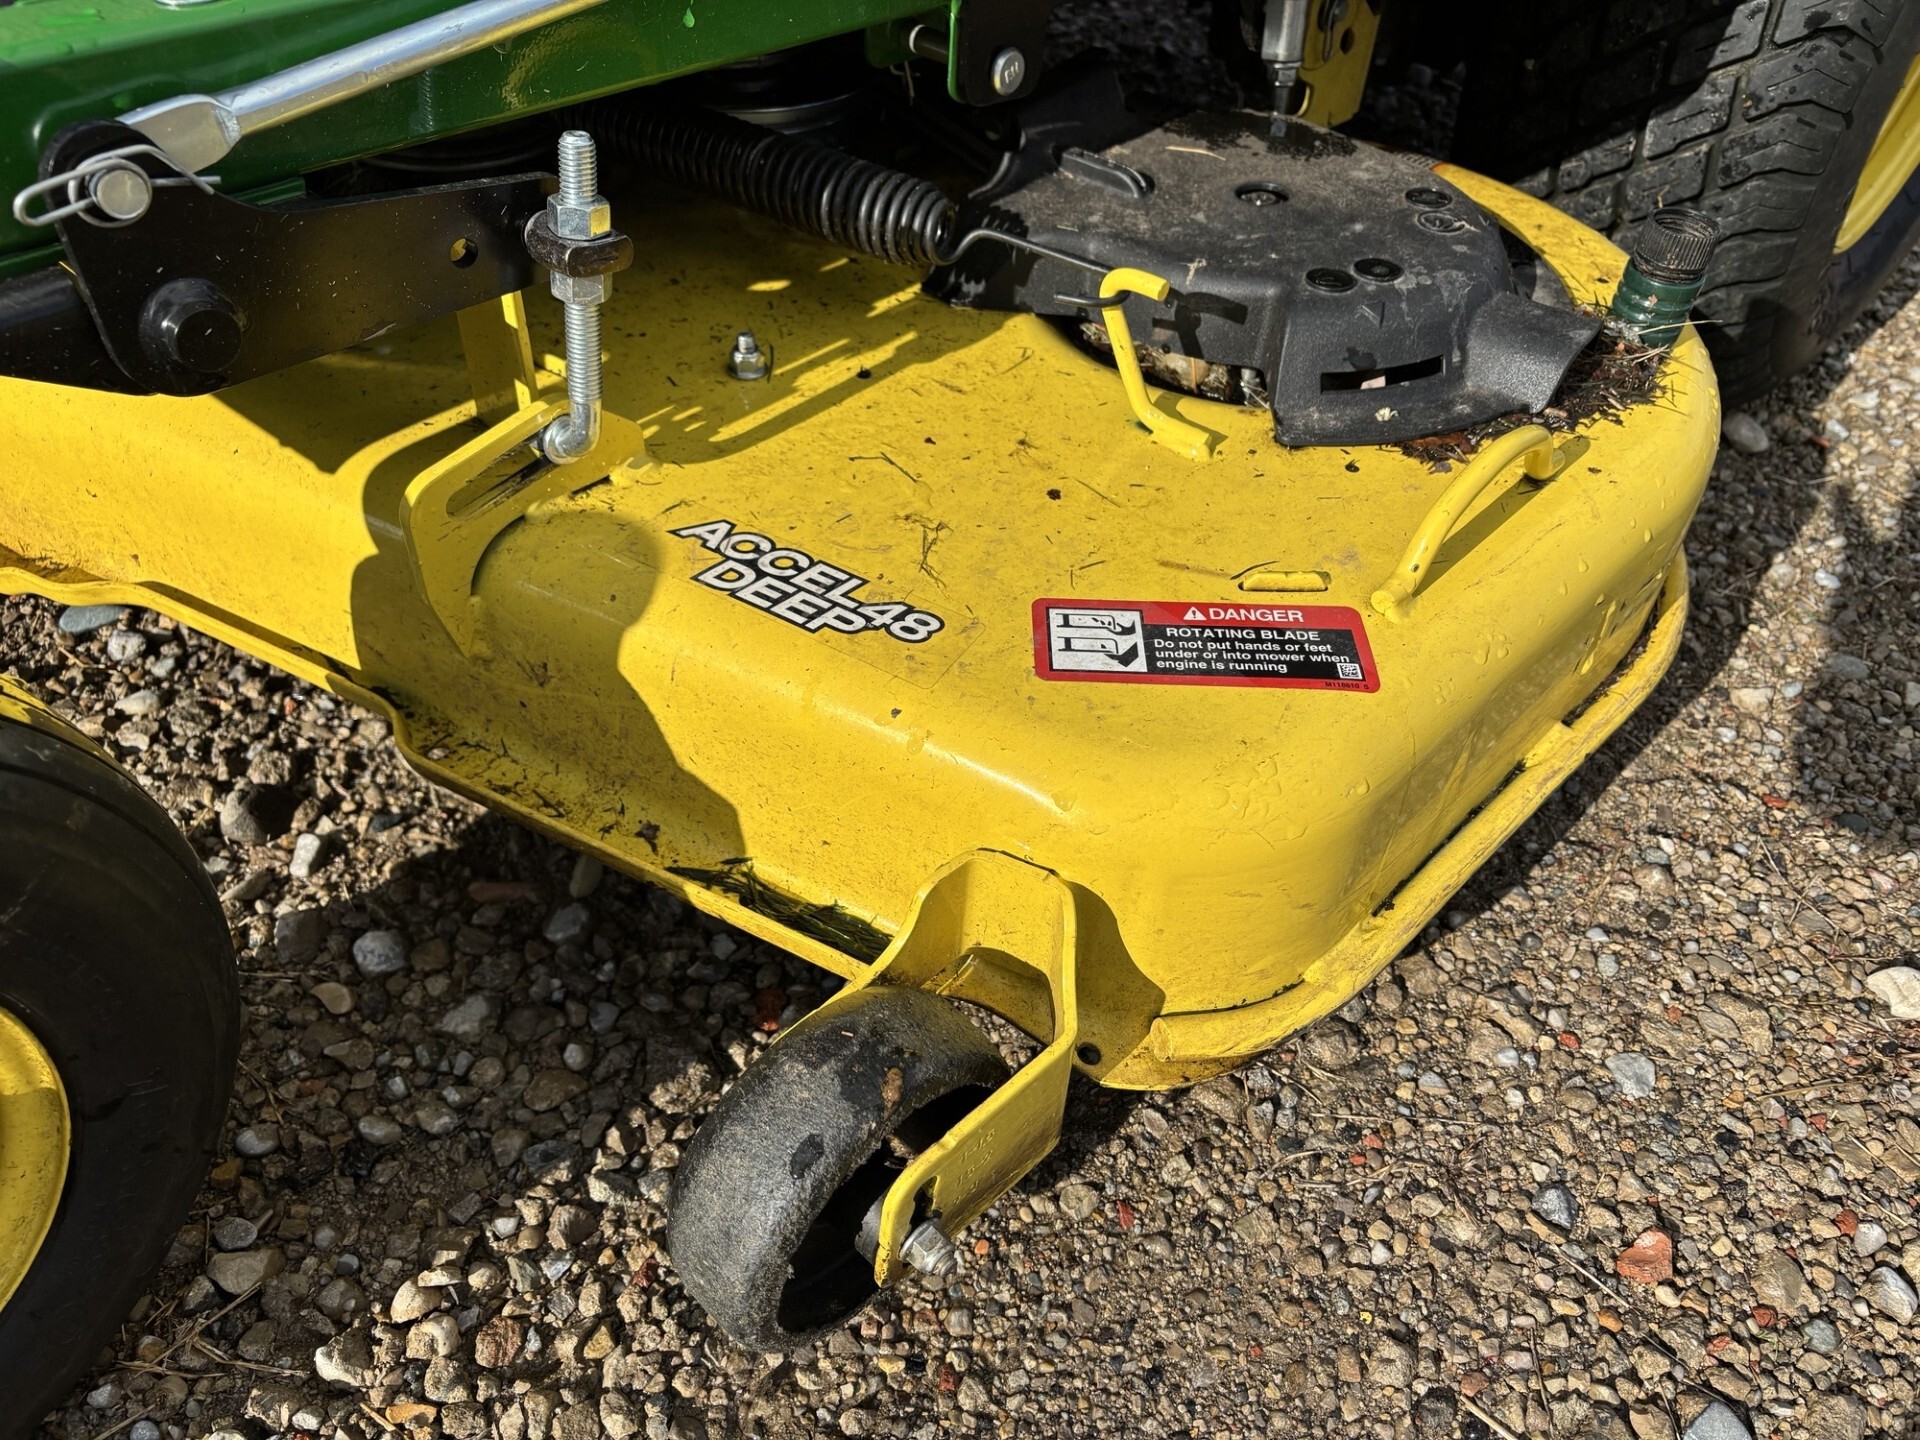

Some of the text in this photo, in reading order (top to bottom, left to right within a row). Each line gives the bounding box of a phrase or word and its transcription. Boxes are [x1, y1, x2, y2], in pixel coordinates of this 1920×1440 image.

[669, 520, 868, 608] ACCEL
[692, 559, 868, 634] DEEP
[1208, 607, 1304, 622] DANGER
[1165, 627, 1321, 641] ROTATING BLADE
[1154, 638, 1175, 648] Do
[1179, 640, 1203, 649] not
[1206, 641, 1231, 651] put
[1234, 641, 1281, 651] hands
[1303, 644, 1333, 653] feet
[1155, 649, 1199, 659] under
[1222, 650, 1252, 660] into
[1255, 652, 1306, 662] mower
[1309, 653, 1350, 663] when
[1156, 660, 1288, 673] engine is running
